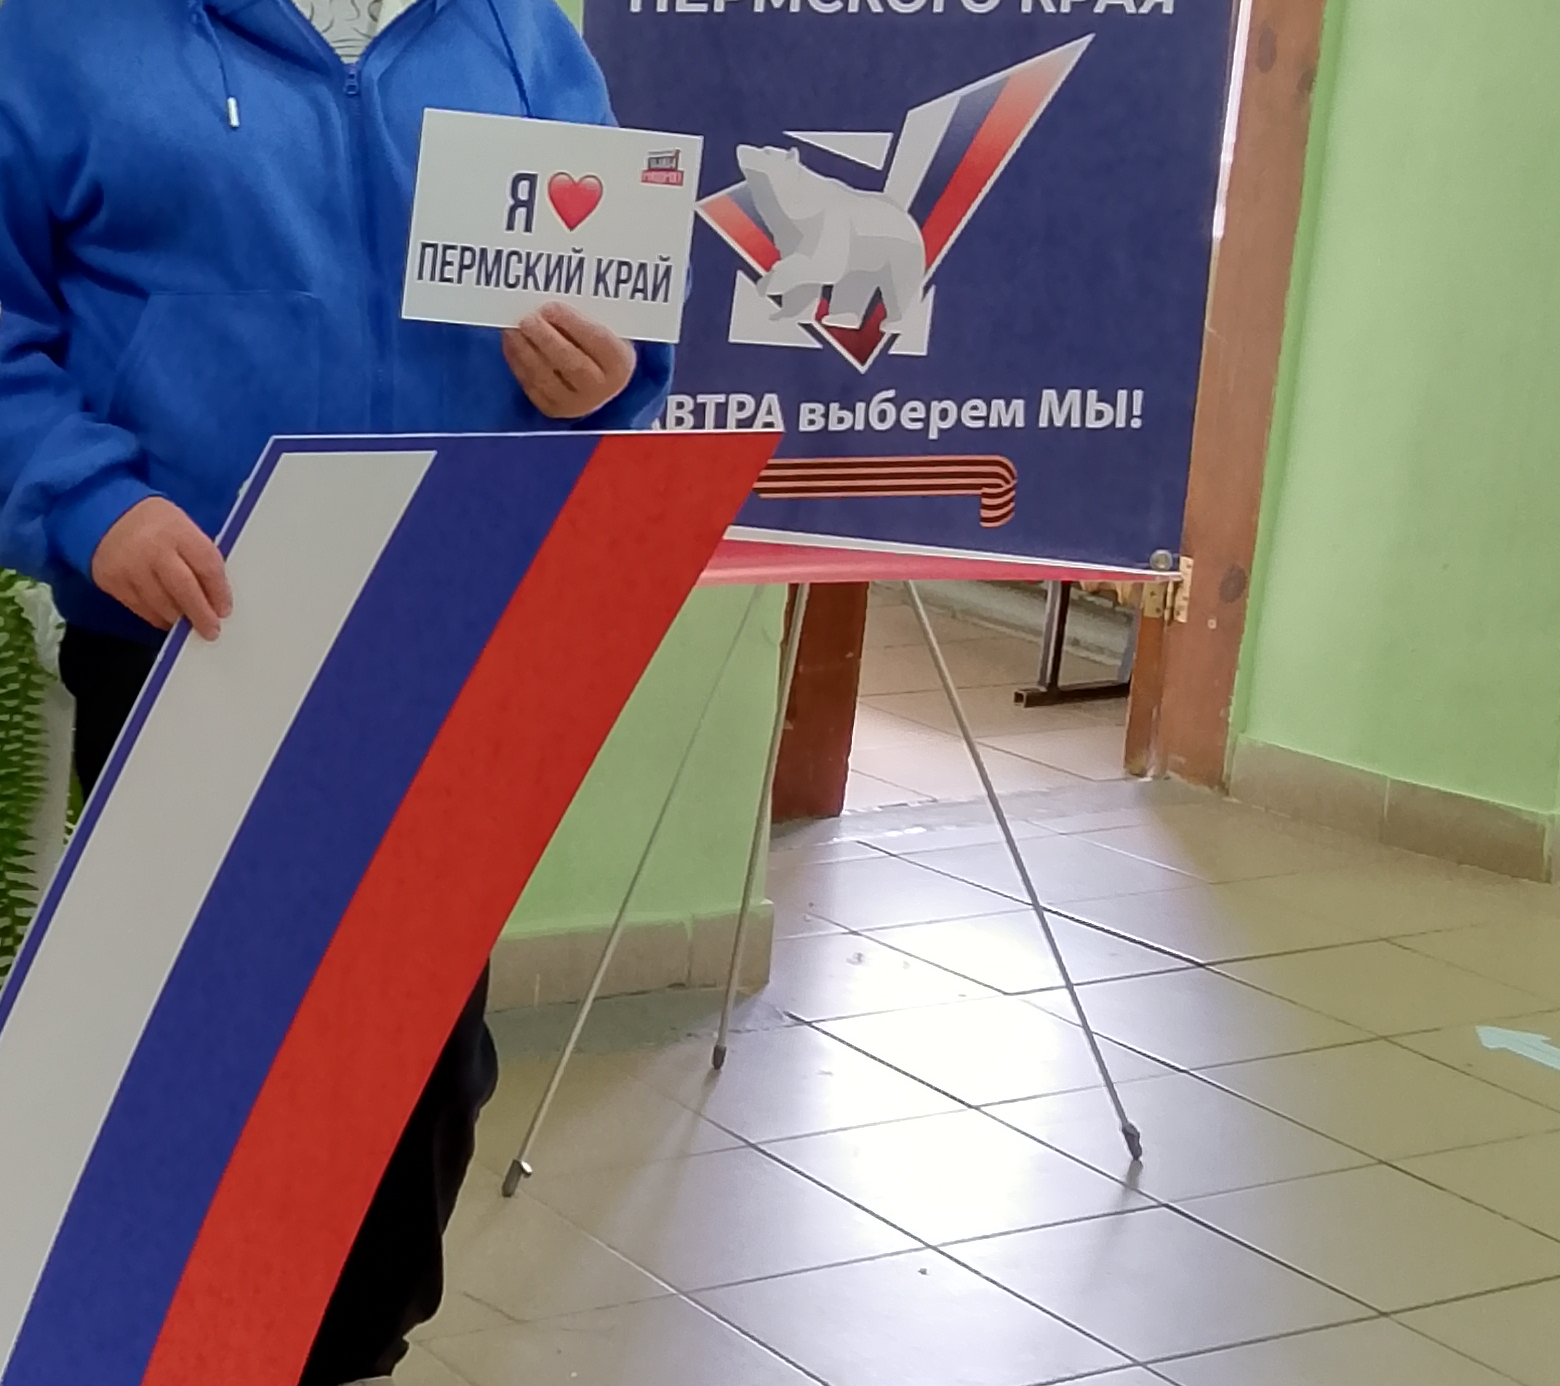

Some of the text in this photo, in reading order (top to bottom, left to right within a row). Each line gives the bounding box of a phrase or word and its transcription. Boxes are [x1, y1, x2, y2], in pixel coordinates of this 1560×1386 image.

[505, 171, 539, 233] Я
[416, 241, 673, 303] ПЕРМСКИЙ КРАЙ
[652, 389, 1144, 439] ВТРА выберем МЫ!
